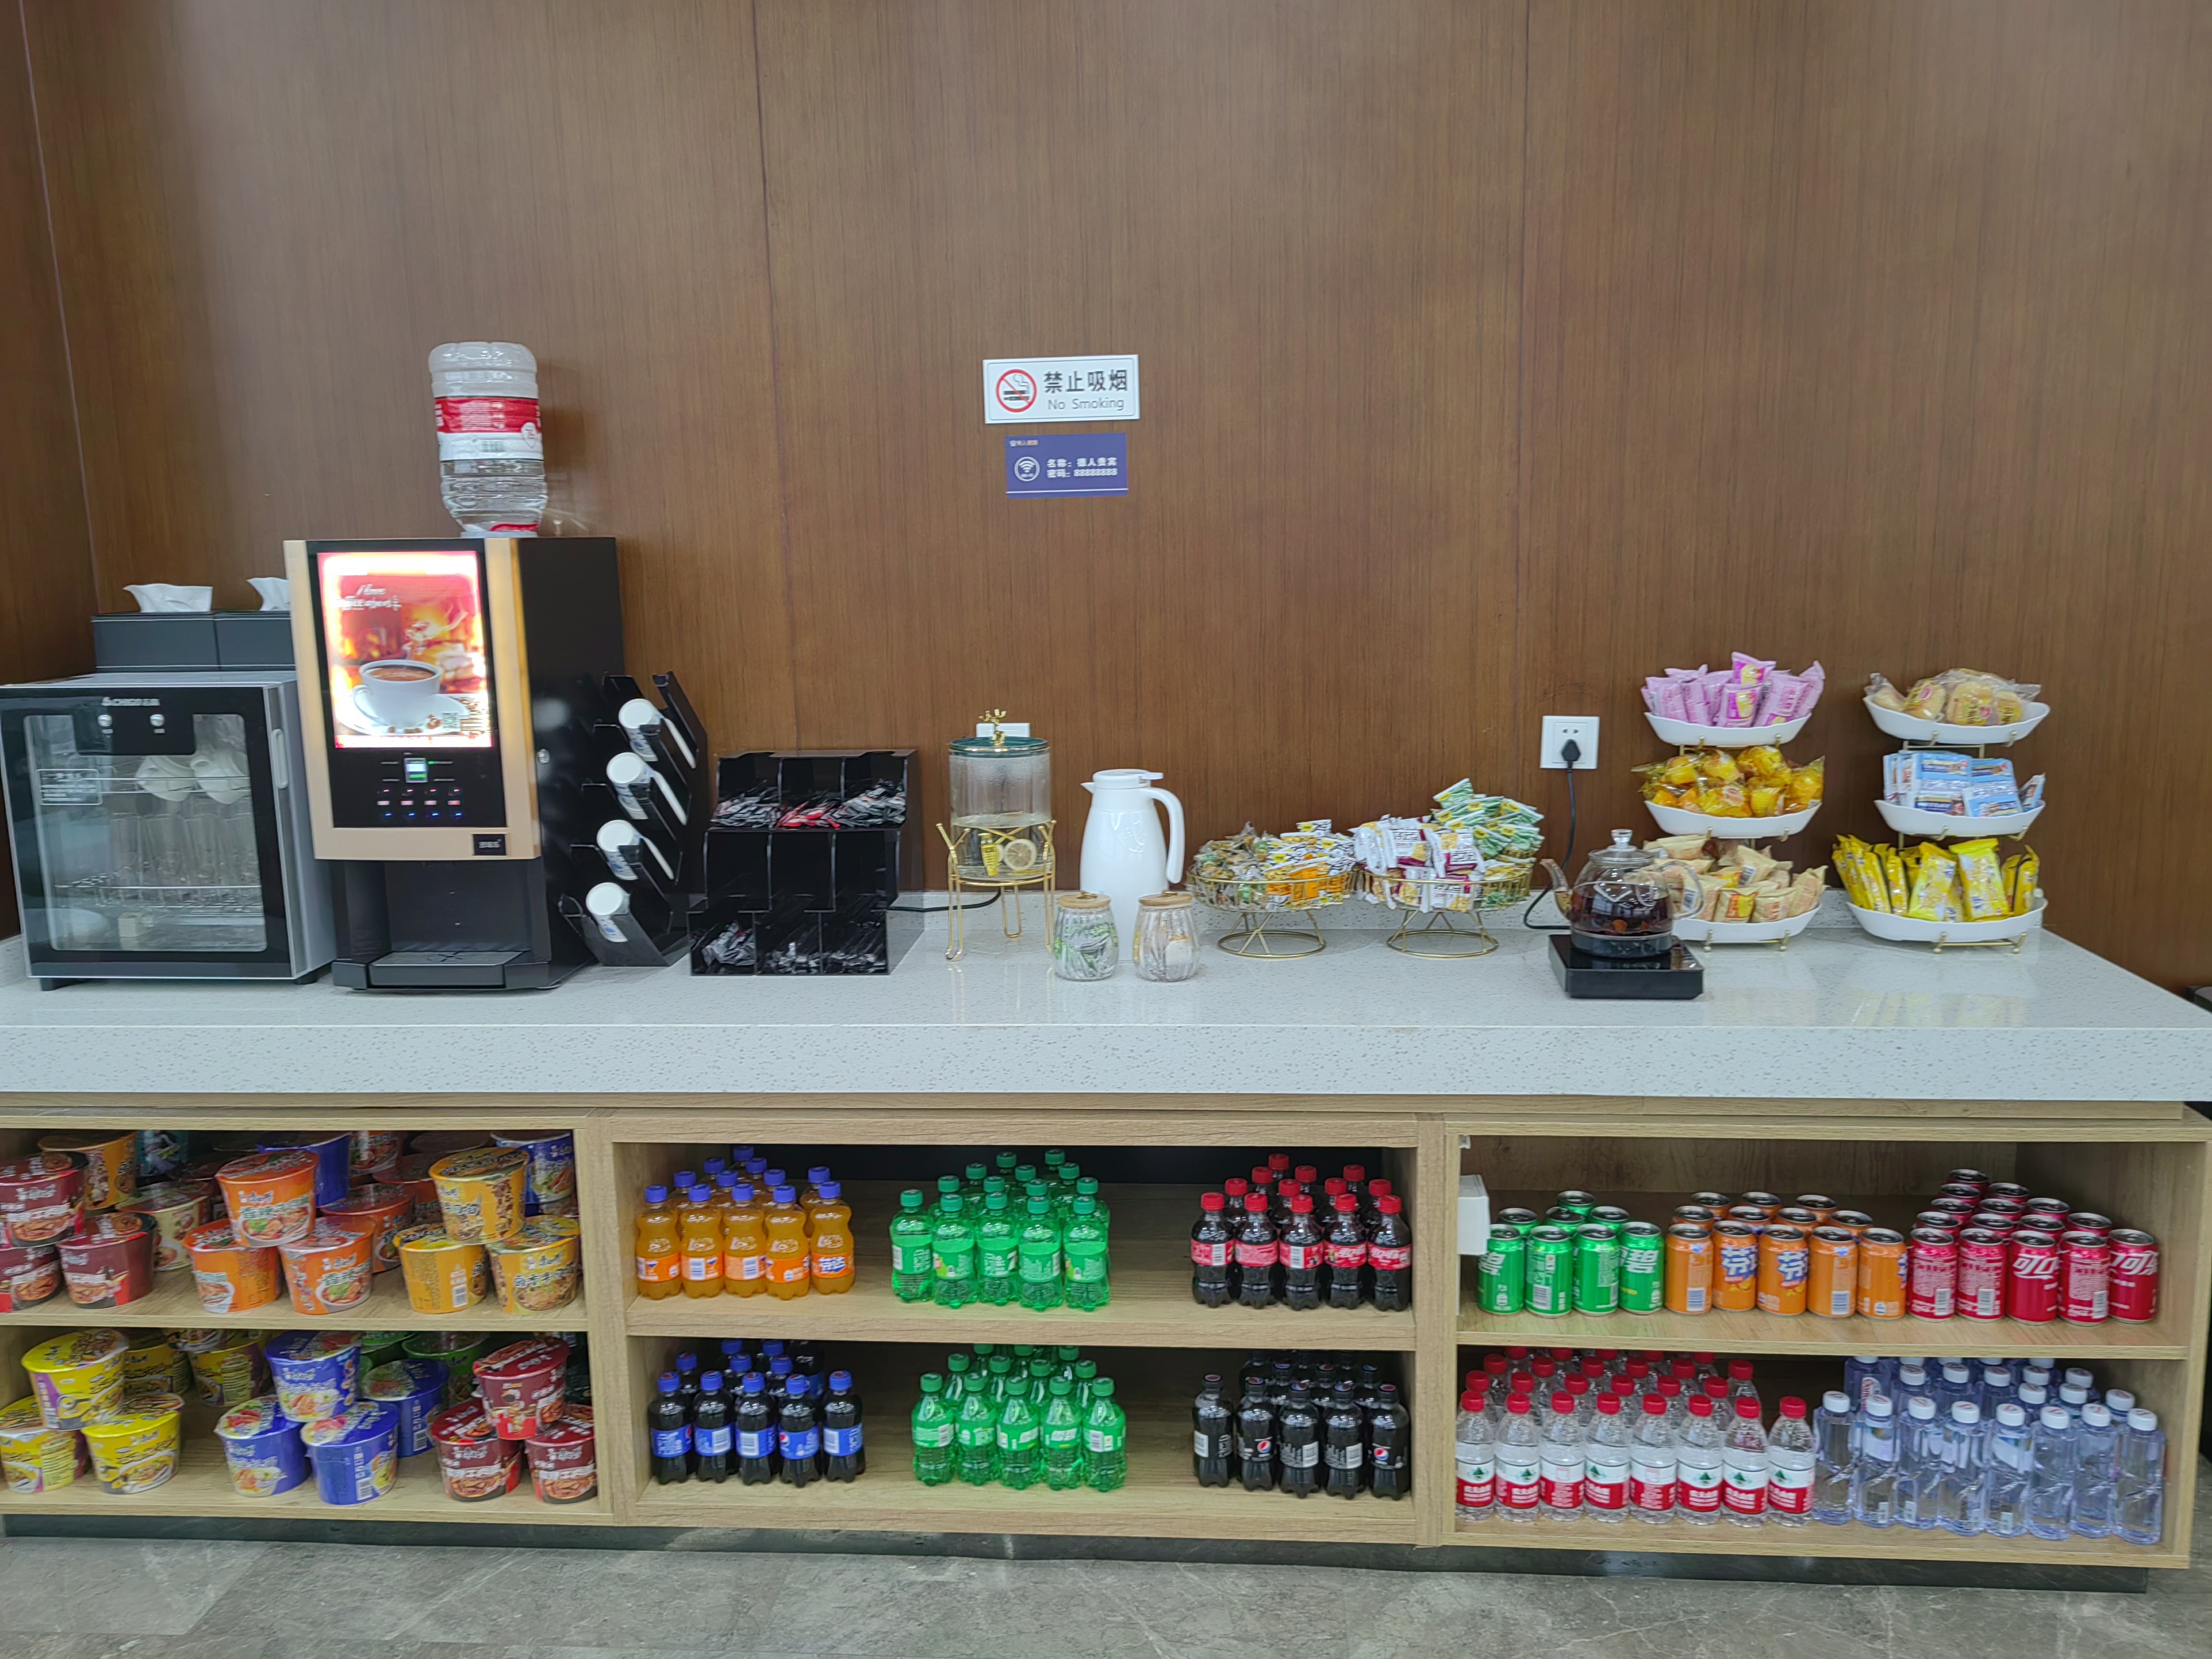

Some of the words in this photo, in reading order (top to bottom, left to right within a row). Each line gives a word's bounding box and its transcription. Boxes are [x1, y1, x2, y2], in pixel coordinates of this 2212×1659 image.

[1043, 369, 1128, 394] 禁止吸烟
[1048, 399, 1065, 410] No
[1071, 397, 1124, 410] Smoking
